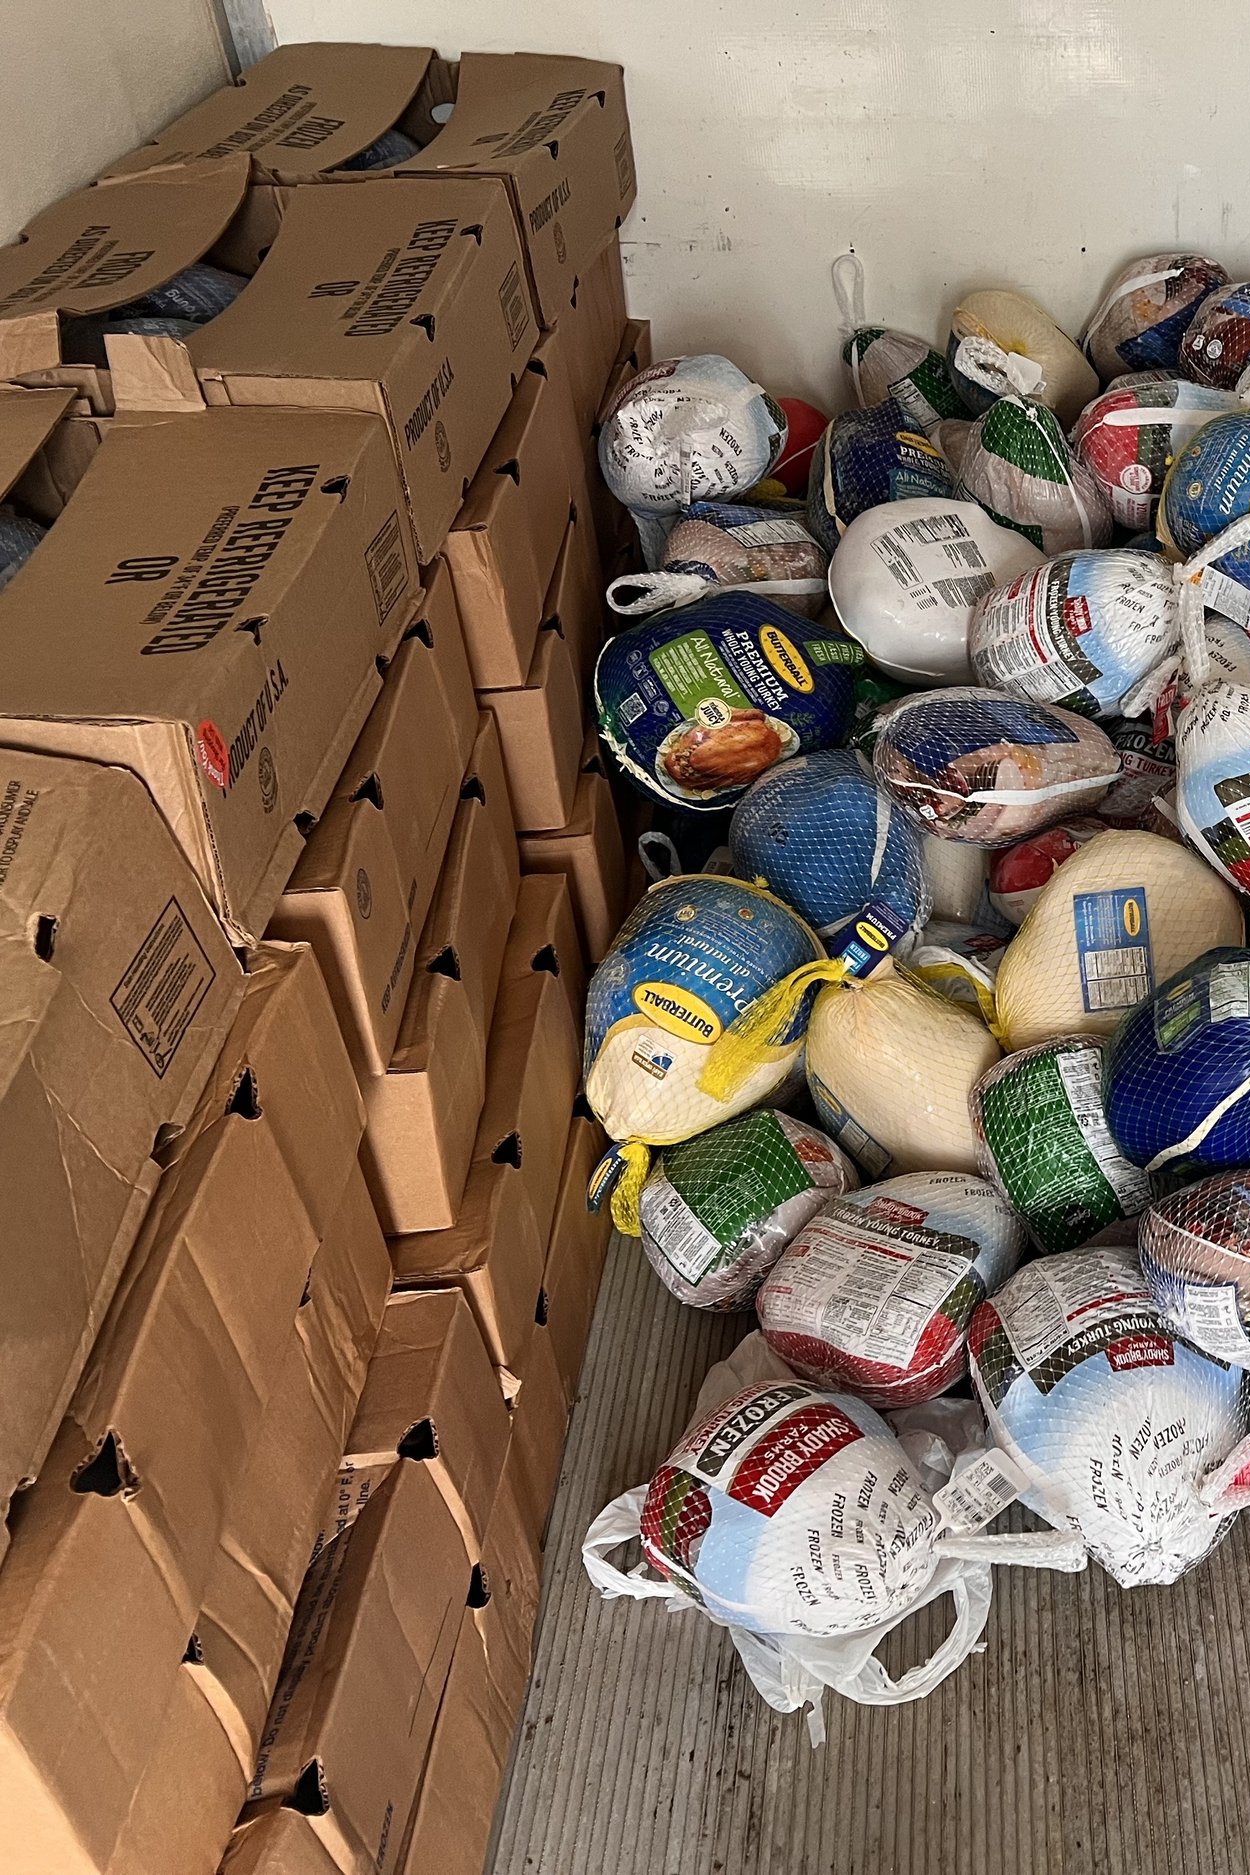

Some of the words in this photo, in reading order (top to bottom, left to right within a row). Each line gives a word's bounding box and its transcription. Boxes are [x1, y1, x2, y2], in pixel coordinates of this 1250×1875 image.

[288, 84, 313, 96] AS
[275, 116, 346, 149] FROZEN
[81, 225, 111, 237] AS
[407, 218, 459, 251] KEEP
[307, 281, 361, 298] OR
[344, 254, 442, 337] REFRIGERATED
[404, 394, 433, 451] PRODUCT
[429, 376, 441, 411] OF
[719, 427, 743, 457] FROZEN
[1237, 434, 1249, 450] all
[248, 464, 320, 513] KEEP
[1215, 448, 1239, 494] natural
[104, 556, 180, 585] OR
[140, 517, 293, 655] REFRIGERATED
[1116, 596, 1146, 614] FROZEN
[690, 637, 708, 656] All
[704, 652, 740, 698] Natural
[722, 629, 744, 661] WHOLE
[740, 657, 760, 687] YOUNG
[758, 681, 783, 712] TURKEY
[736, 631, 789, 701] PREMIUM
[765, 631, 809, 687] BUTTERBALL
[254, 690, 268, 732] OF
[700, 705, 722, 726] JUICY
[1136, 757, 1176, 777] TURKEY
[866, 912, 897, 940] PREMIUM
[677, 934, 731, 966] natural
[733, 963, 750, 977] all
[646, 943, 759, 1015] Premium
[643, 990, 714, 1038] BUTTERBALL
[864, 1219, 901, 1237] YOUNG
[900, 1230, 940, 1248] TURKEY
[1067, 1324, 1113, 1356] TURKEY
[1114, 1317, 1156, 1332] YOUNG
[691, 1408, 732, 1456] TURKEY
[709, 1390, 792, 1456] FROZEN
[801, 1418, 850, 1458] SHADY
[752, 1449, 804, 1503] BROOK
[857, 1470, 878, 1511] FROZEN
[1090, 1457, 1109, 1513] FROZEN
[340, 1503, 350, 1516] at
[831, 1493, 846, 1538] FROZEN
[808, 1529, 824, 1574] FROZEN
[789, 1565, 821, 1607] FROZEN
[252, 1749, 270, 1798] below.
[261, 1728, 279, 1749] Do
[273, 1703, 288, 1729] not
[305, 1612, 328, 1660] product
